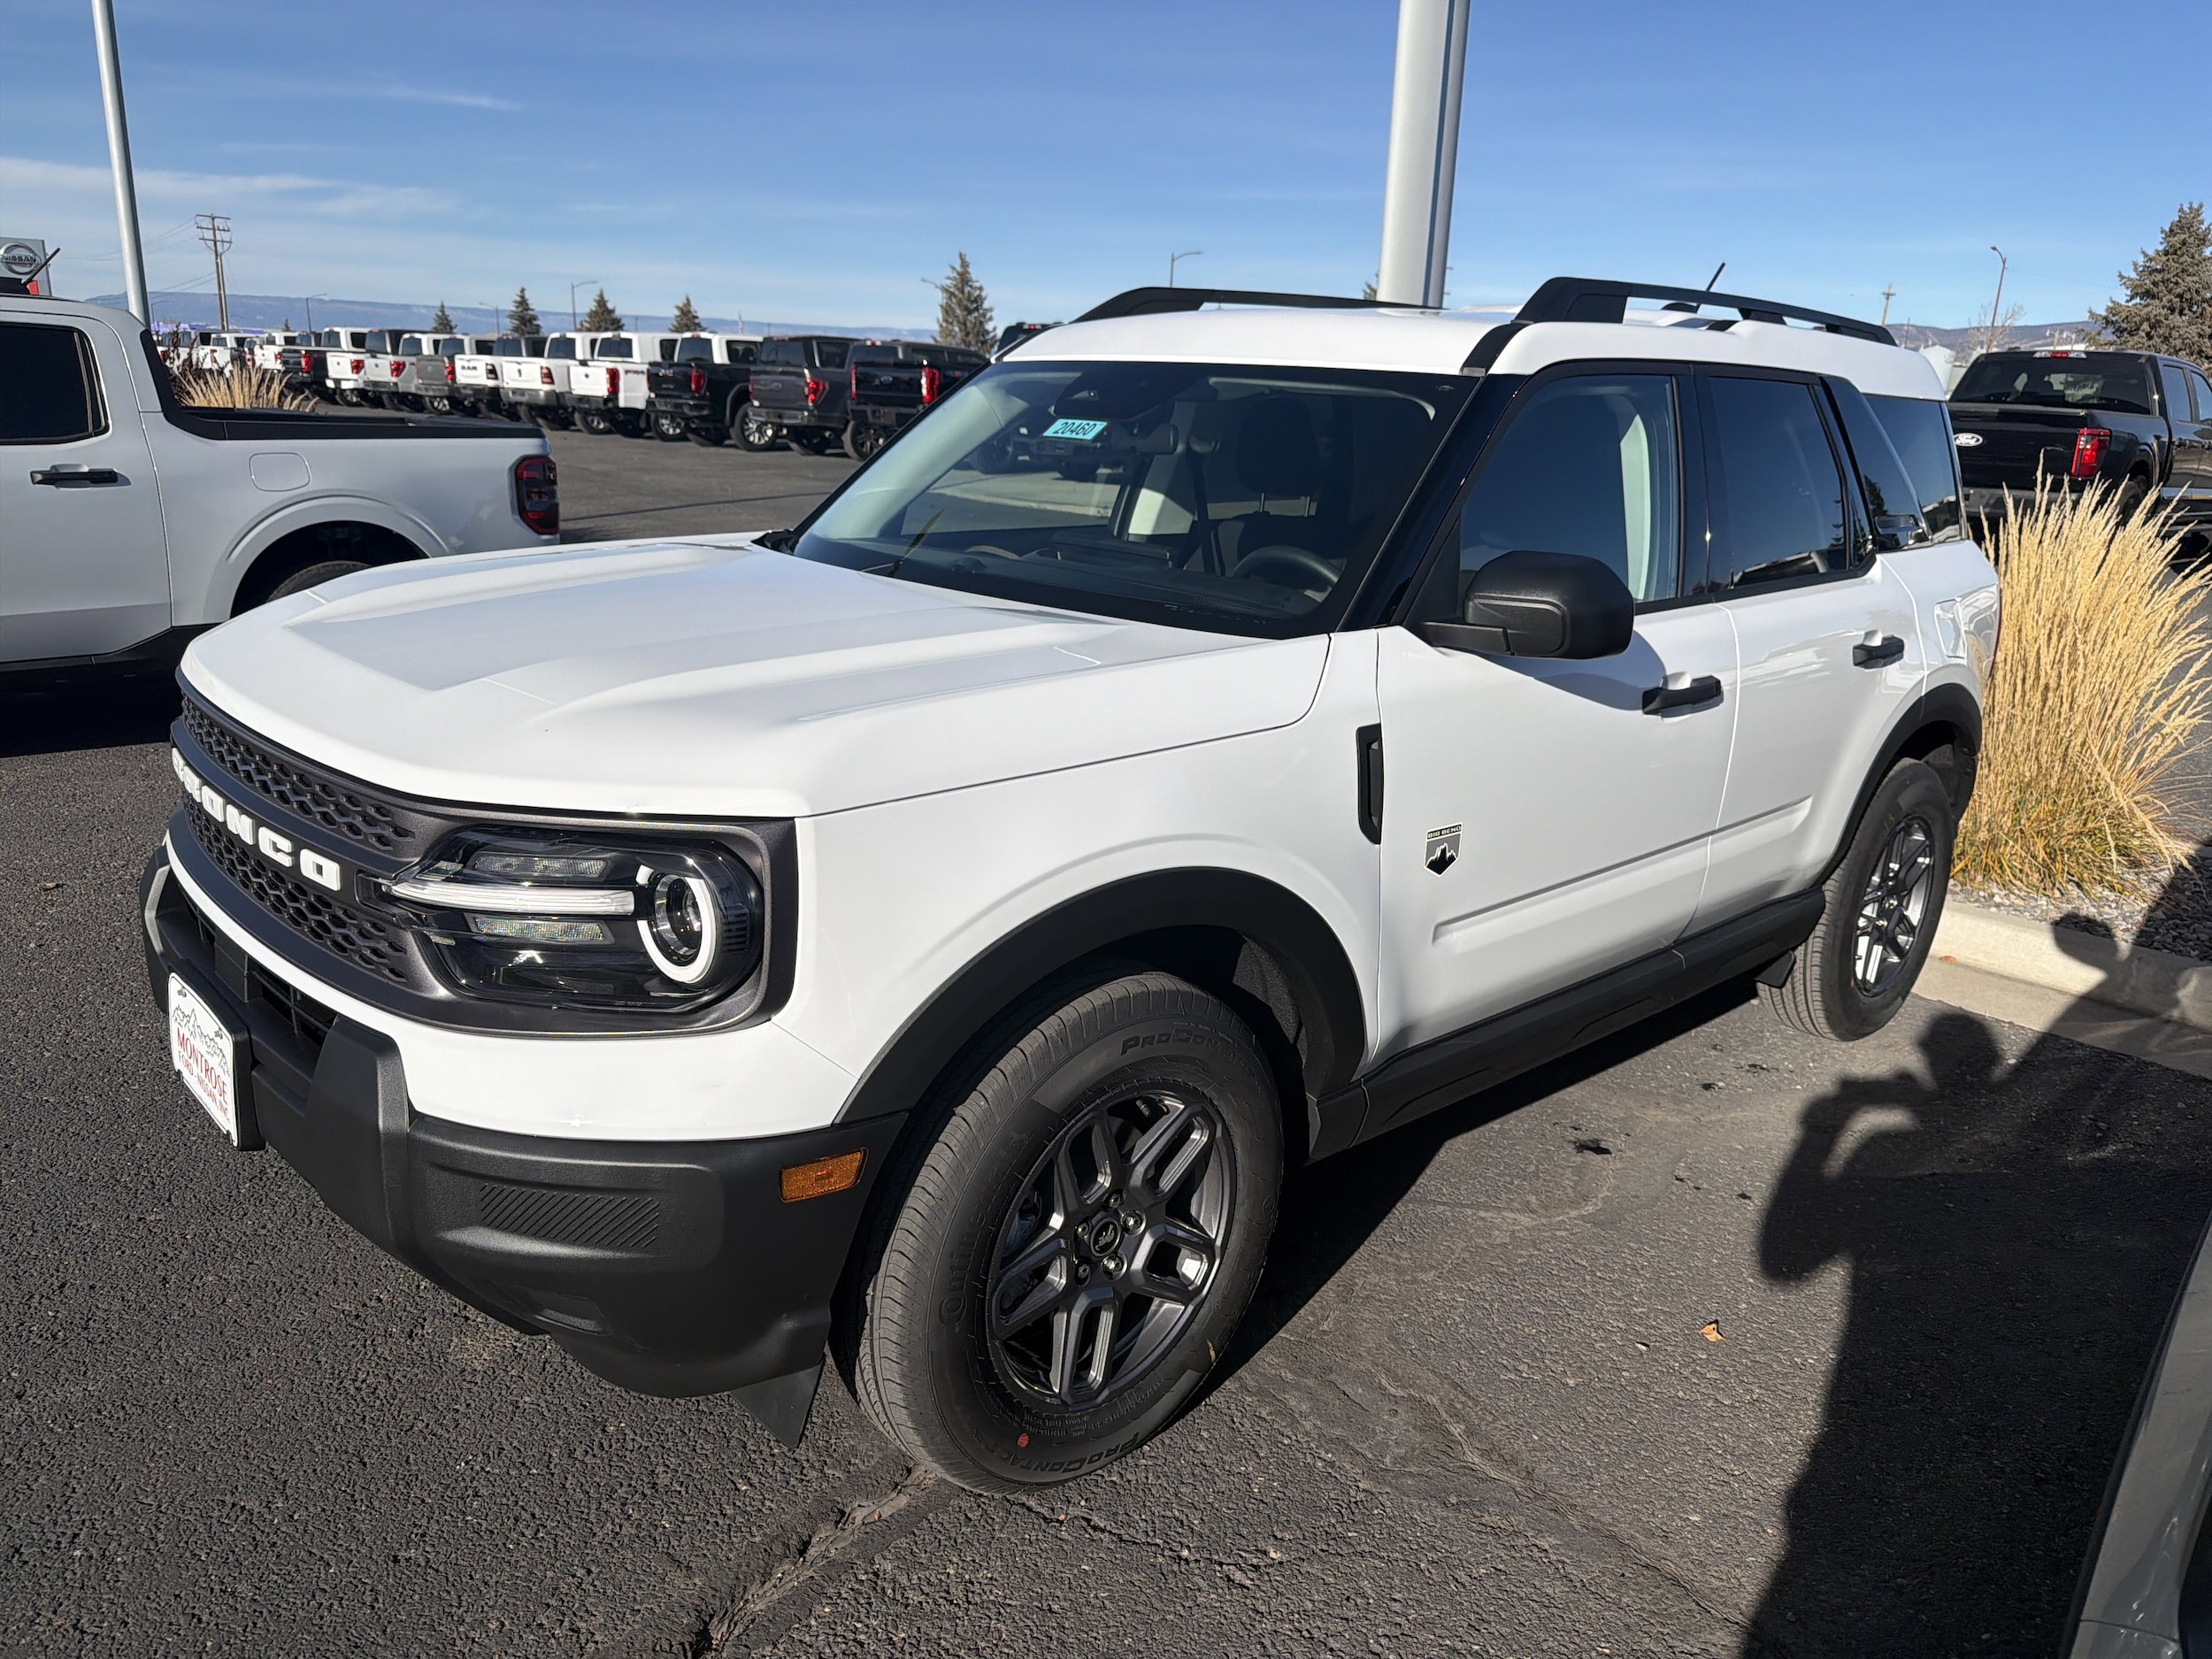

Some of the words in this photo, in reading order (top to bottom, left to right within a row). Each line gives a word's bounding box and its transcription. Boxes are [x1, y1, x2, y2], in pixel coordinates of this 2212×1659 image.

[1, 254, 36, 263] NISSAN
[1053, 421, 1097, 436] 20460
[172, 748, 342, 892] BRONCO
[177, 1026, 228, 1106] MONTROSE
[178, 1049, 194, 1077] FORD
